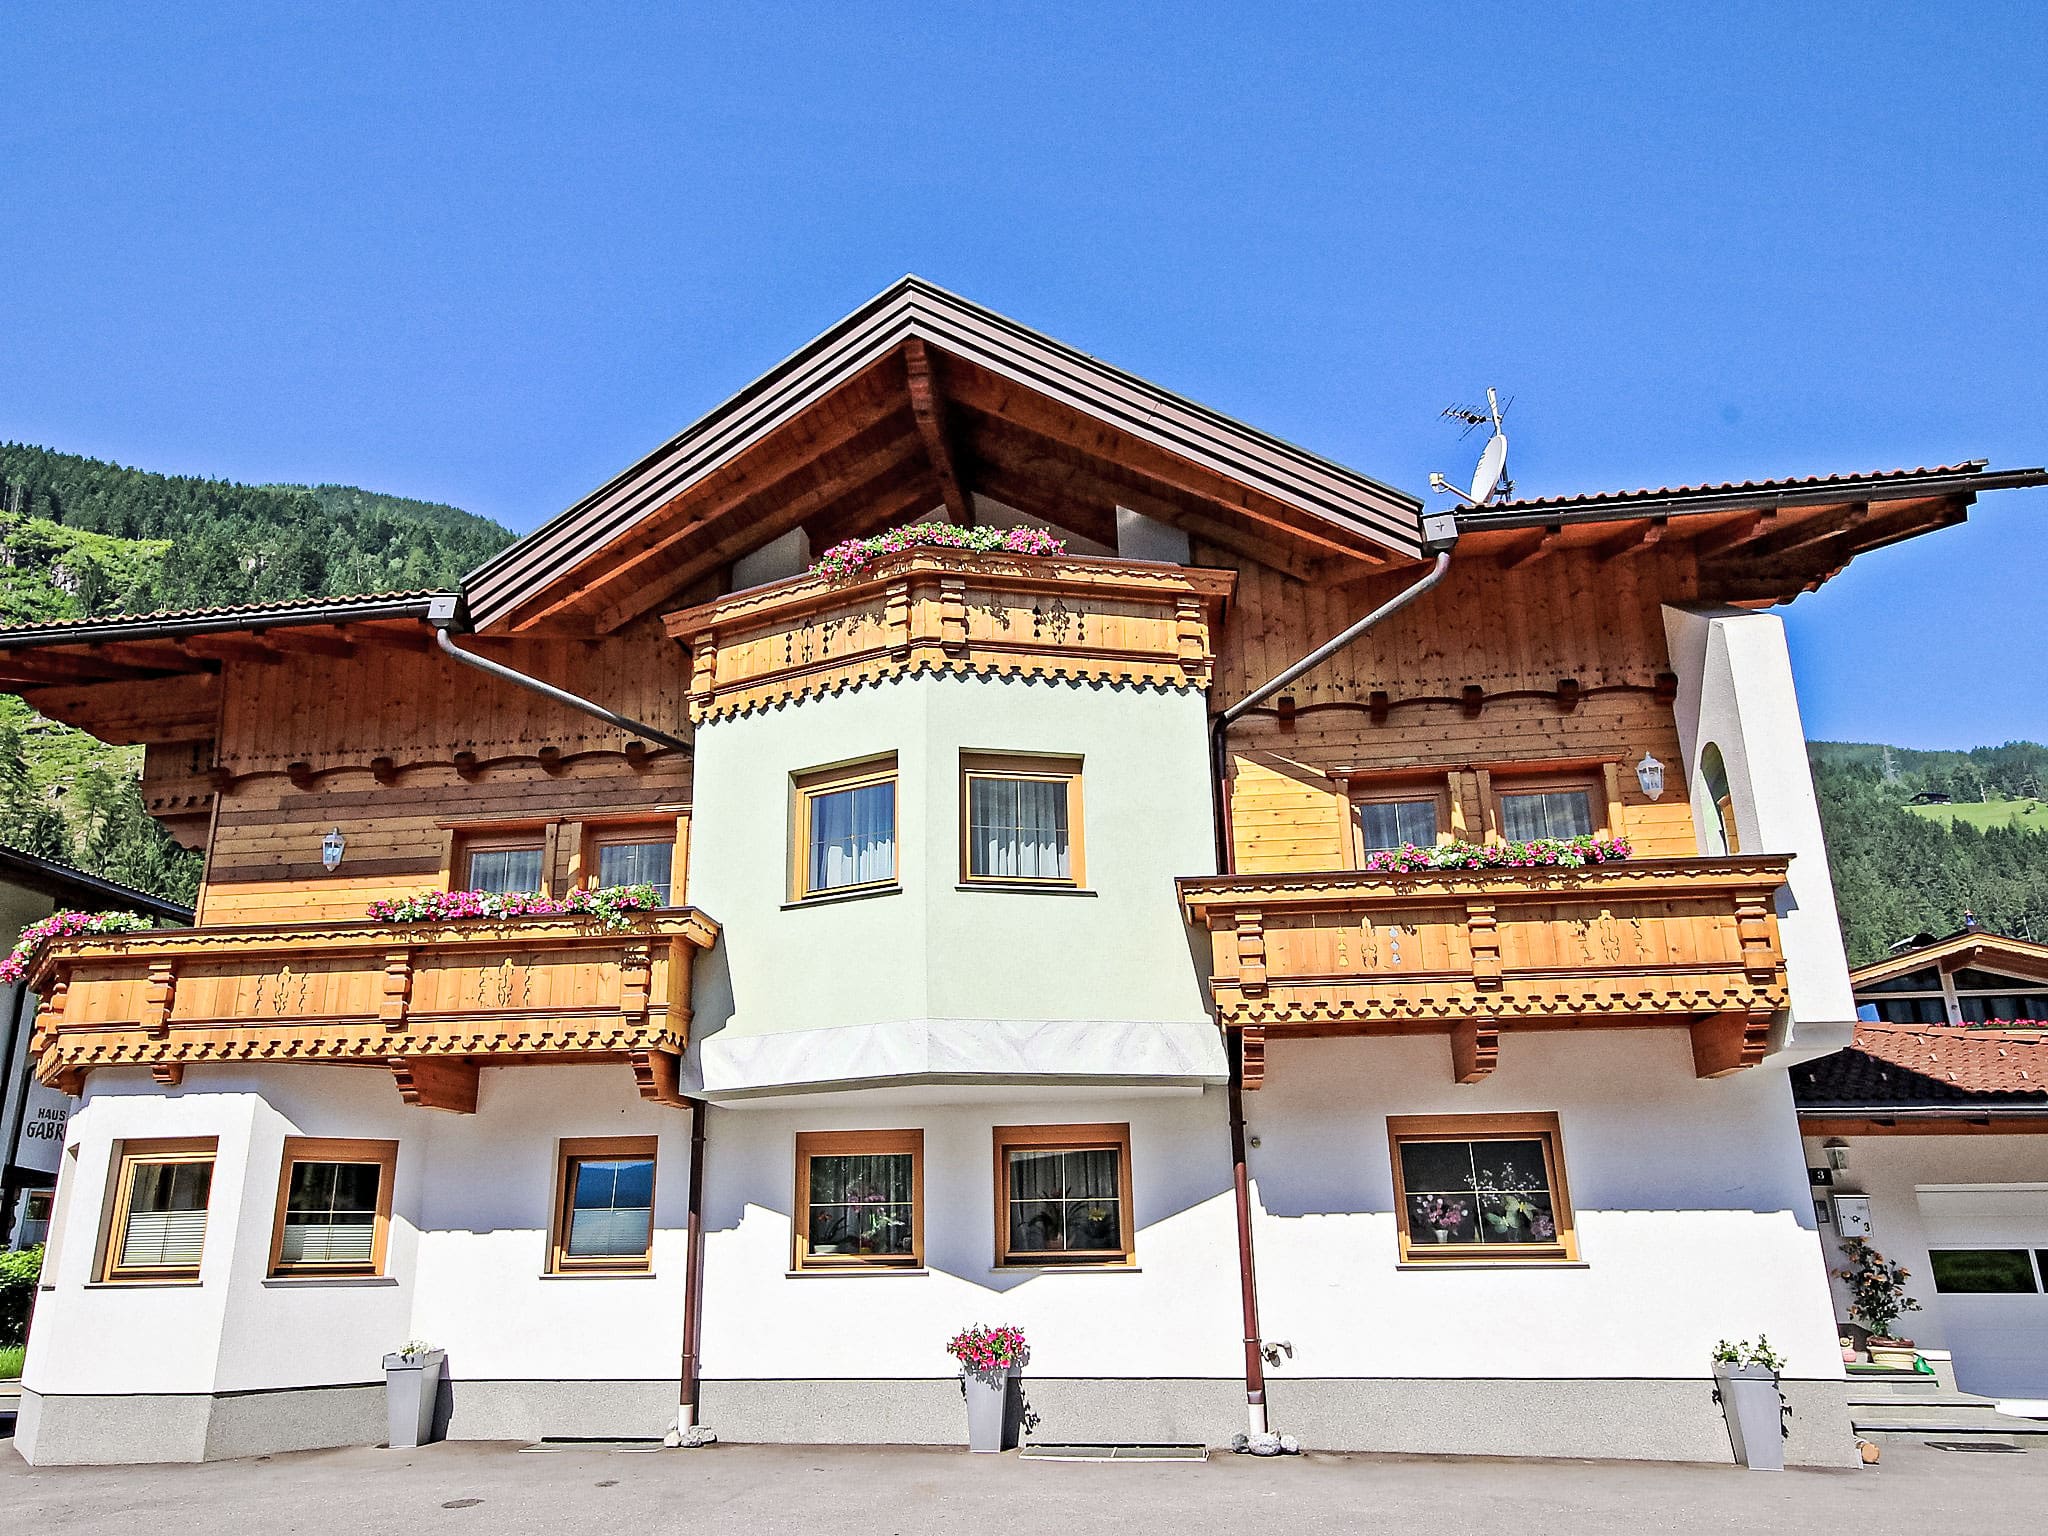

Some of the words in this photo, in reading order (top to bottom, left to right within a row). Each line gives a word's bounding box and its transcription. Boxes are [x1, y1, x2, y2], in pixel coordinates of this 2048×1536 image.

[38, 1108, 66, 1121] HAUS
[1817, 1170, 1825, 1179] 3
[1864, 1222, 1870, 1232] 3
